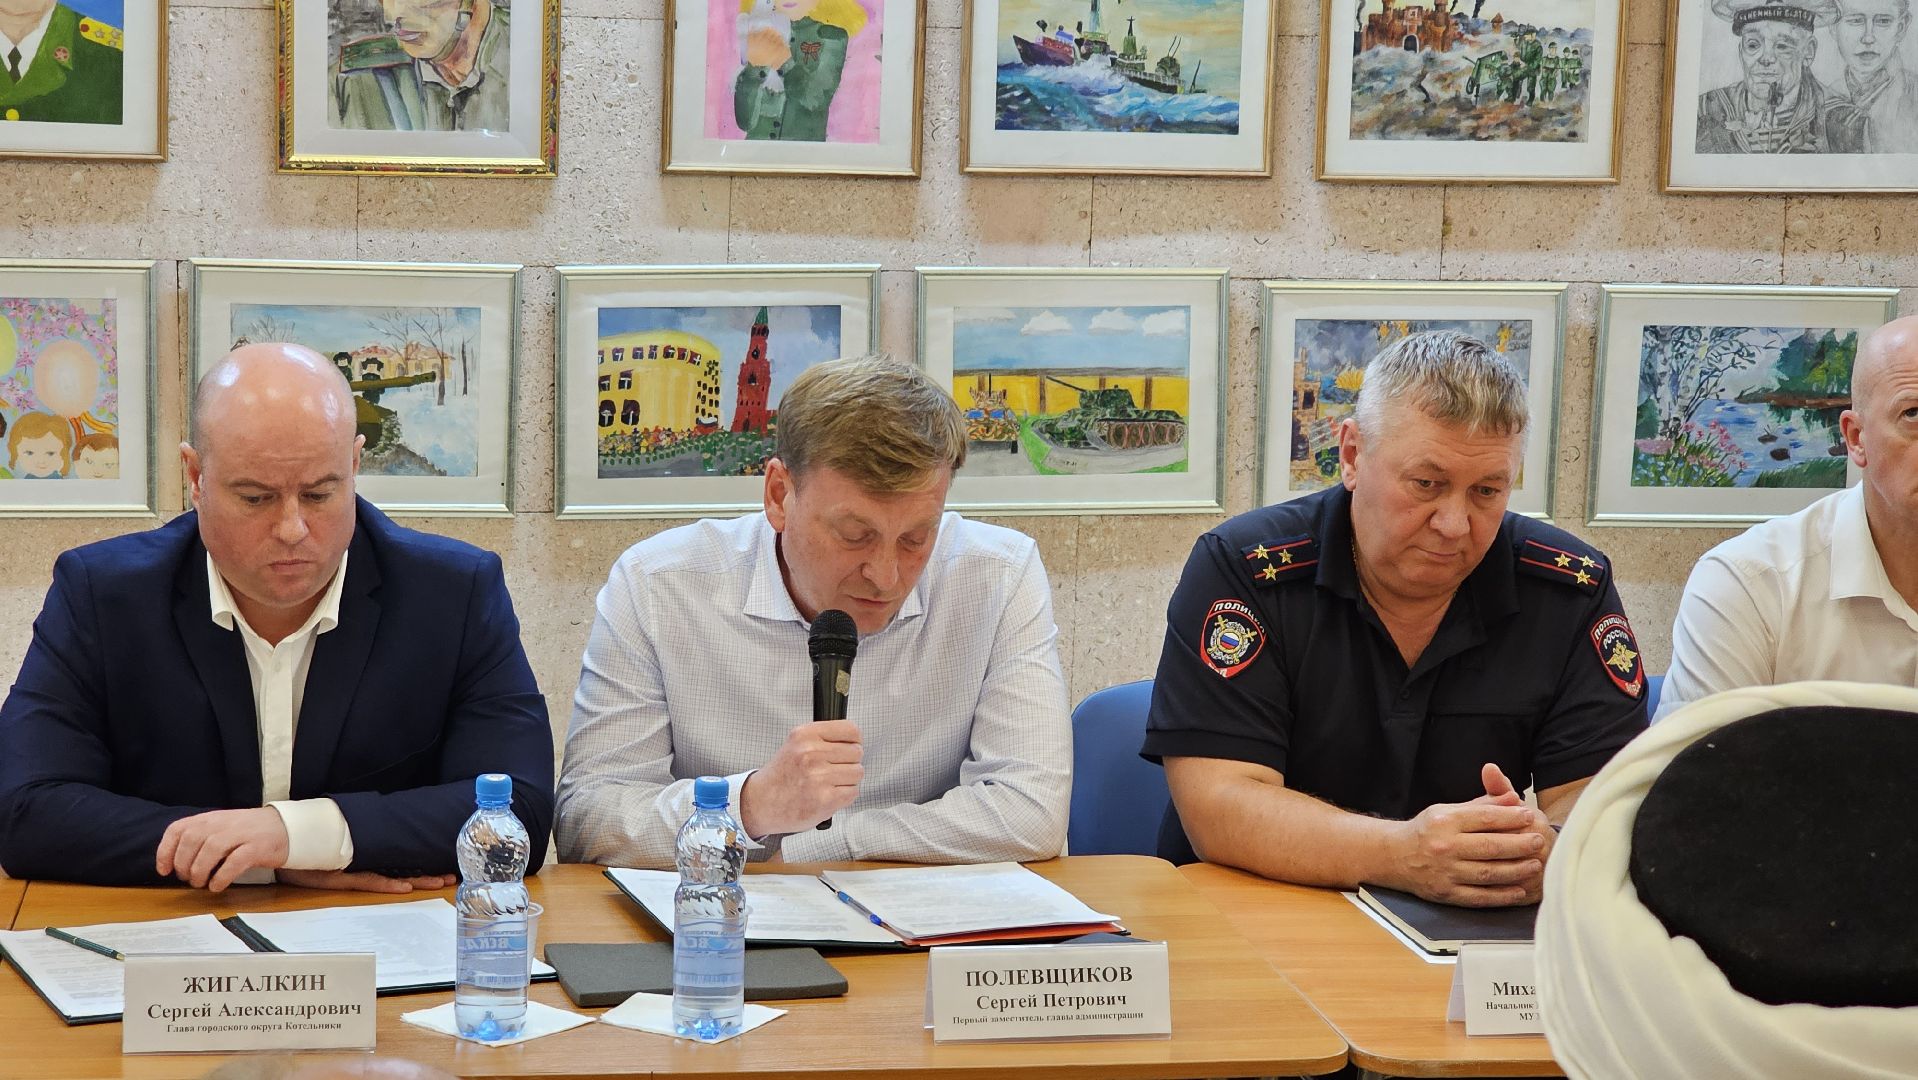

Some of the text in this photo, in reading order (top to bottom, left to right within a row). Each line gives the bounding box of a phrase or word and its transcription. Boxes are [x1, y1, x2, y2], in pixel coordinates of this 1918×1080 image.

[183, 974, 326, 994] ЖИГАЛКИН
[966, 966, 1133, 987] ПОЛЕВЩИКОВ
[1492, 981, 1536, 996] Миха
[976, 993, 1127, 1012] Сергей Петрович
[1486, 1001, 1534, 1010] Начальник
[147, 1002, 361, 1022] Сергей Александрович
[952, 1012, 1144, 1026] Первый заместитель главы администрации
[167, 1021, 342, 1034] Глава городского округа Котельники
